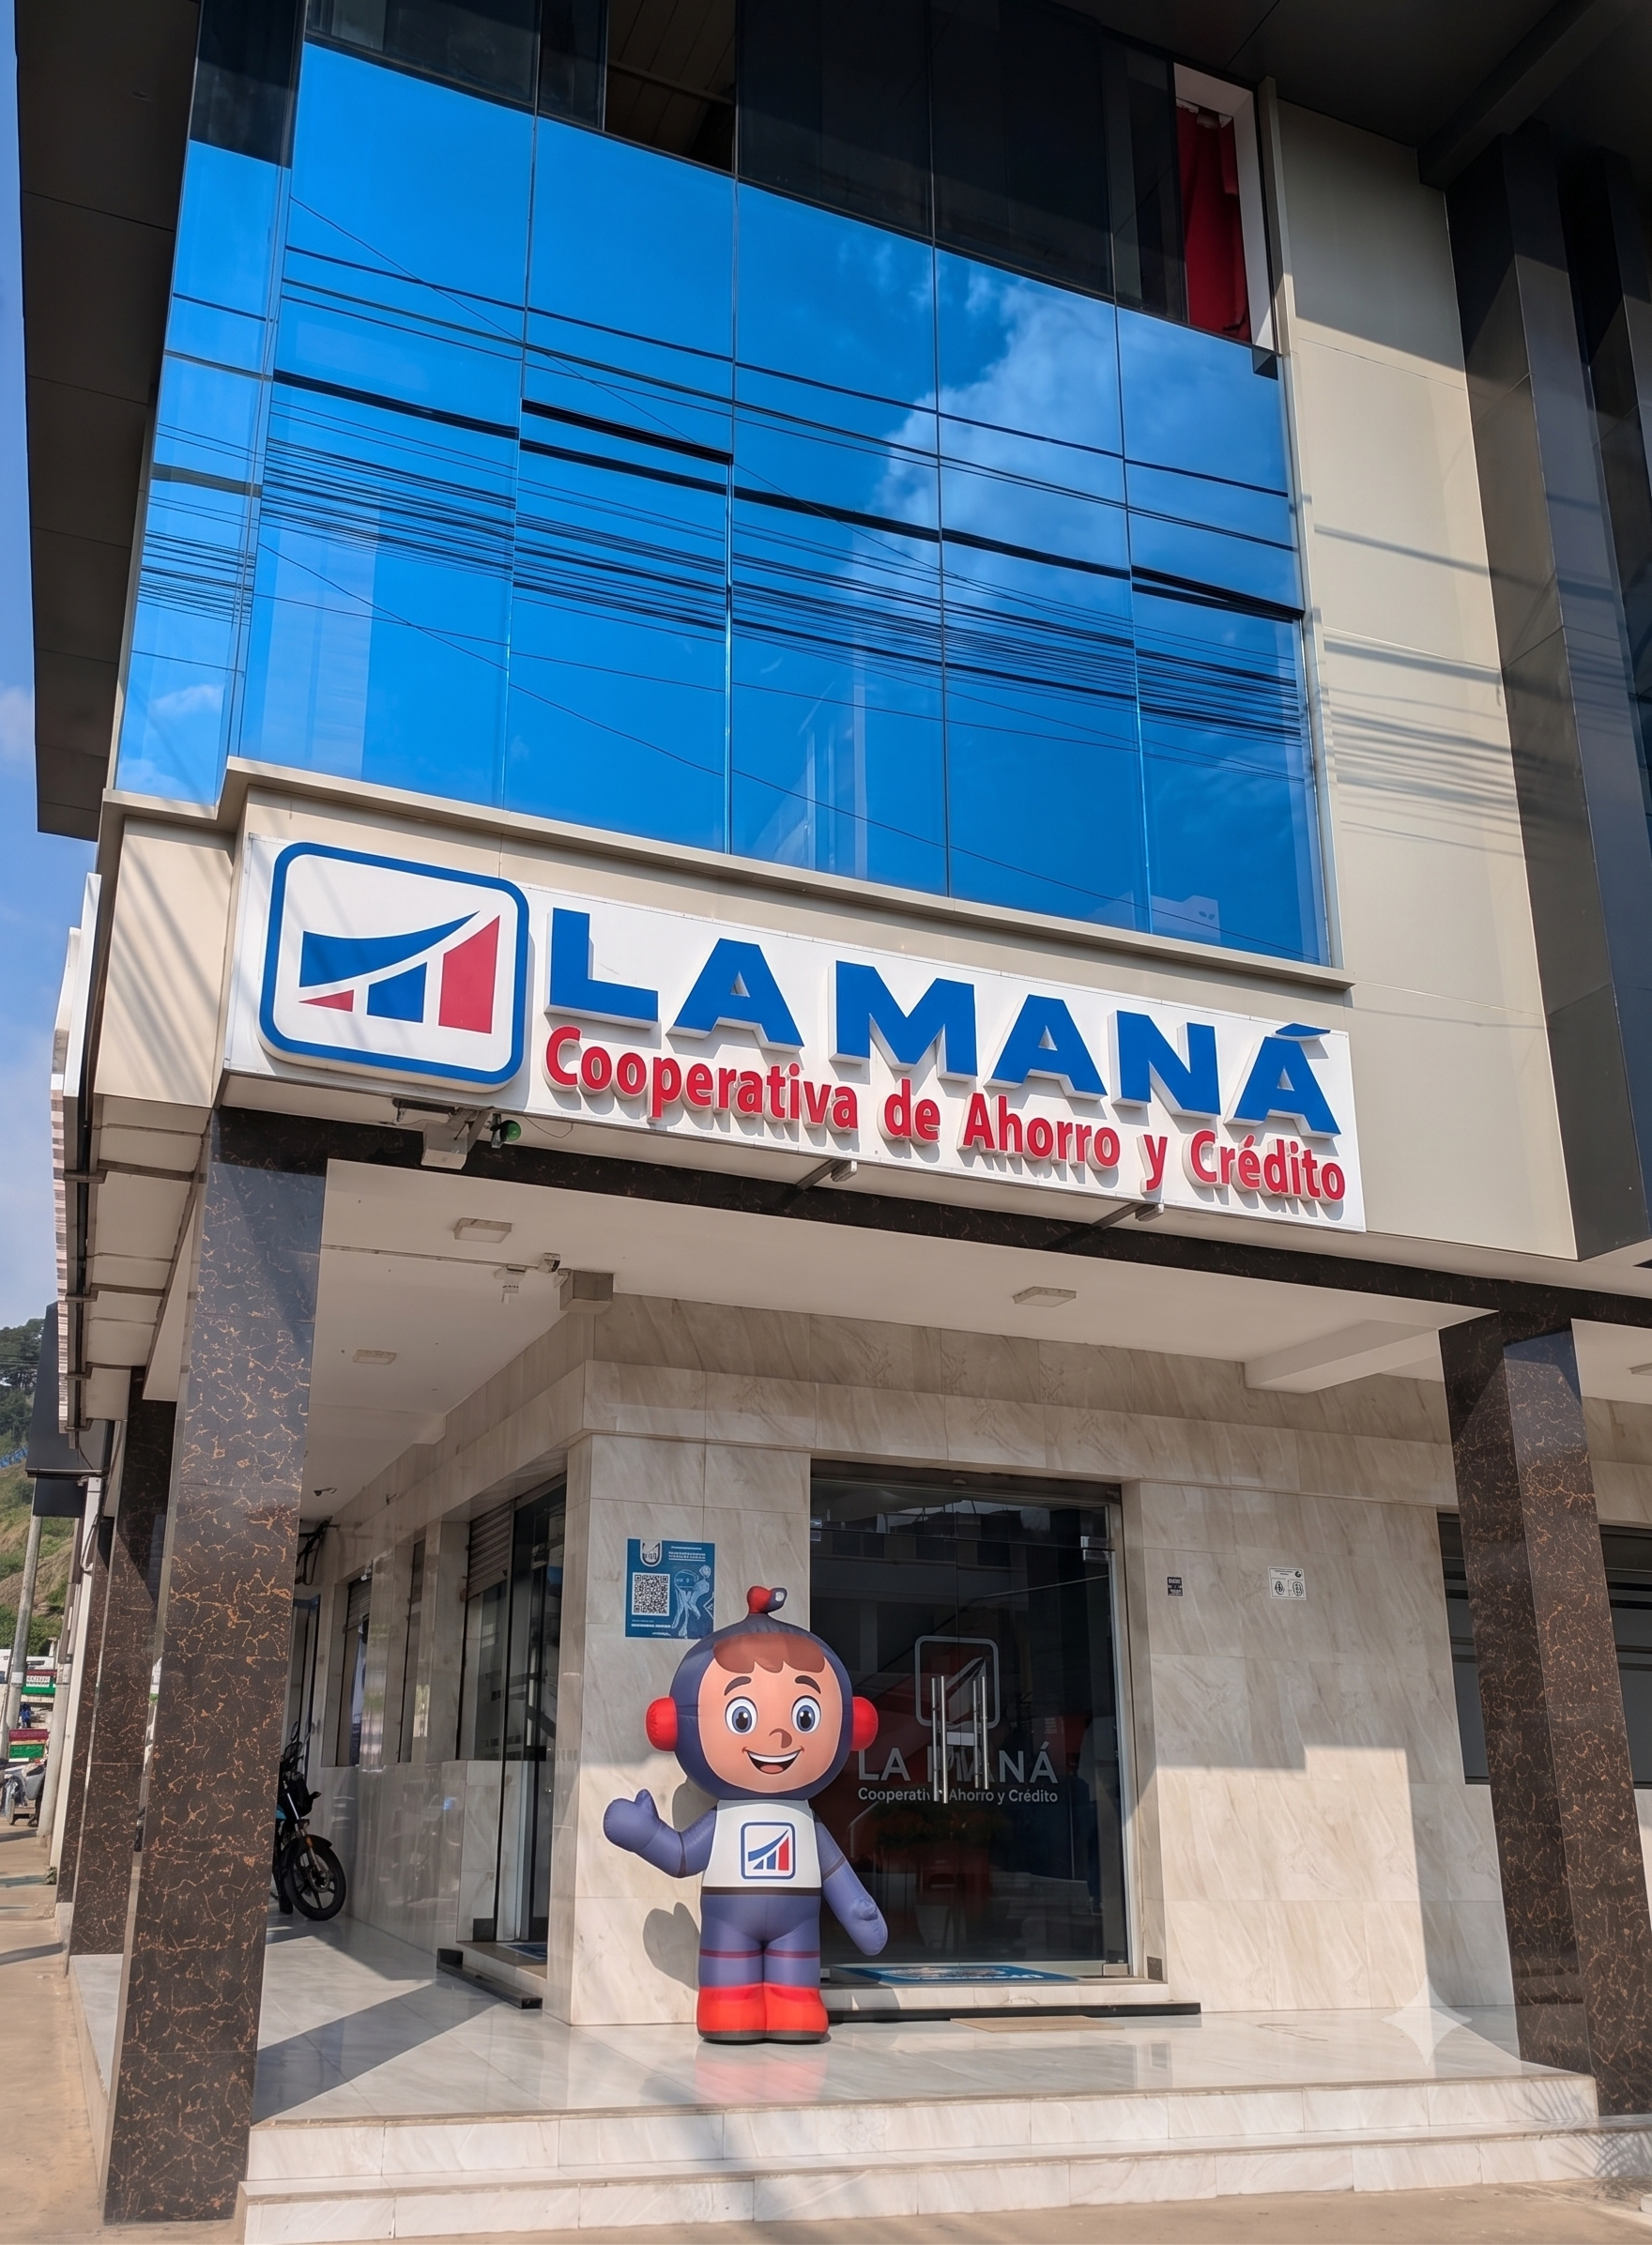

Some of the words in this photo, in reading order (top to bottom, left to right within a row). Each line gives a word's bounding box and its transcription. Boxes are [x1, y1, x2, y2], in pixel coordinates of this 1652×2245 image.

[548, 908, 803, 1047] LA
[834, 960, 1341, 1135] MANÁ
[545, 1026, 858, 1129] Cooperativa
[884, 1078, 941, 1141] de
[963, 1092, 1120, 1167] Ahorro
[1143, 1135, 1168, 1191] y
[1190, 1130, 1346, 1201] Crédito
[858, 1748, 911, 1781] LA
[949, 1788, 995, 1802] Ahorro
[997, 1792, 1005, 1806] y
[1008, 1788, 1059, 1803] Crédito
